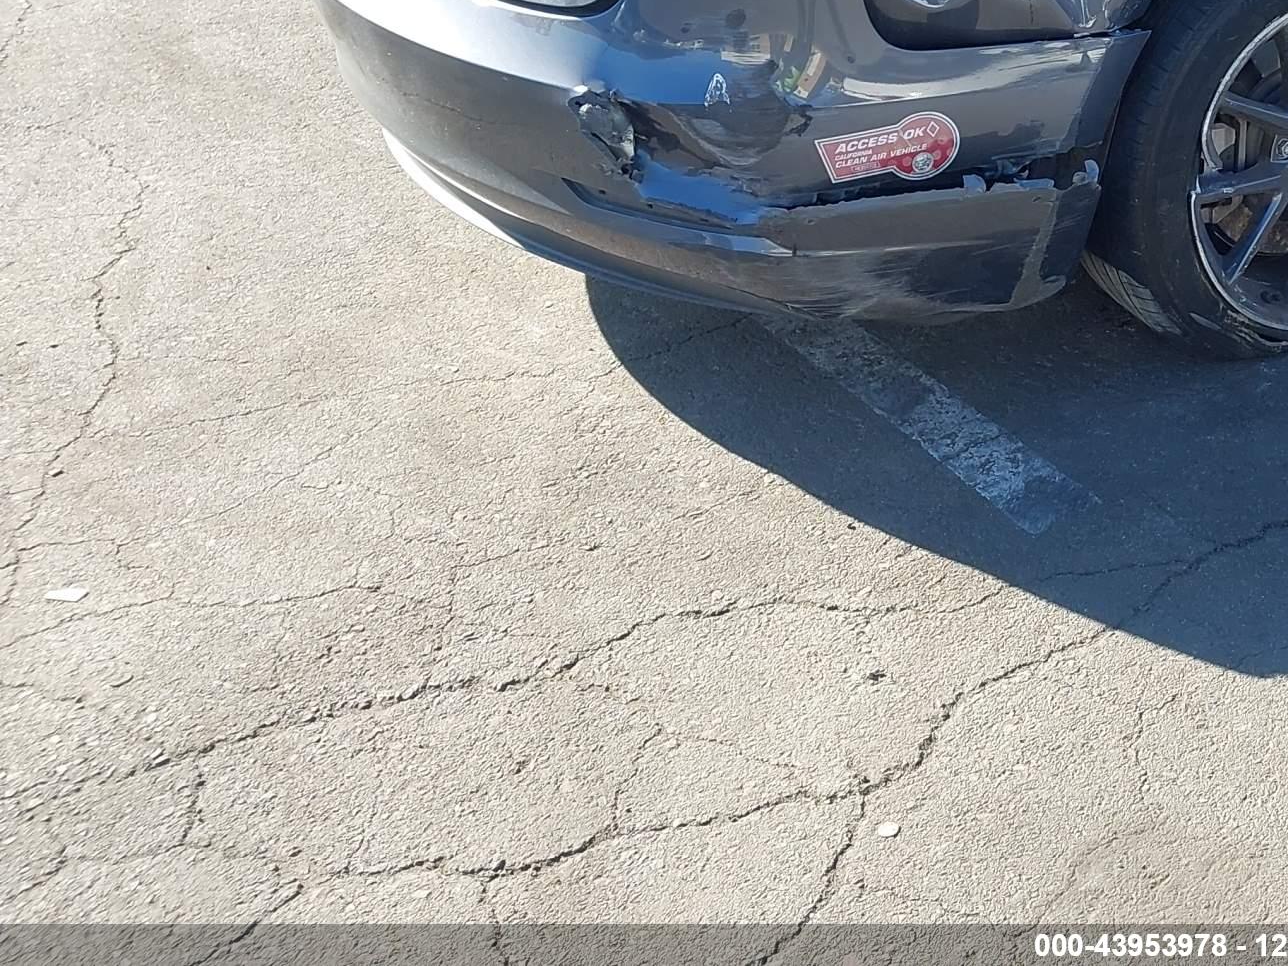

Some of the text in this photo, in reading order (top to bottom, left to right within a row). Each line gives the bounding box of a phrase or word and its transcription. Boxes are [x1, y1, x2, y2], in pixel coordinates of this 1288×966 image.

[834, 126, 927, 154] ACCESS OK
[834, 149, 873, 161] CALIFORNIA
[835, 156, 868, 168] CLEAN
[870, 152, 887, 162] AIR
[890, 143, 928, 157] VEHICLE
